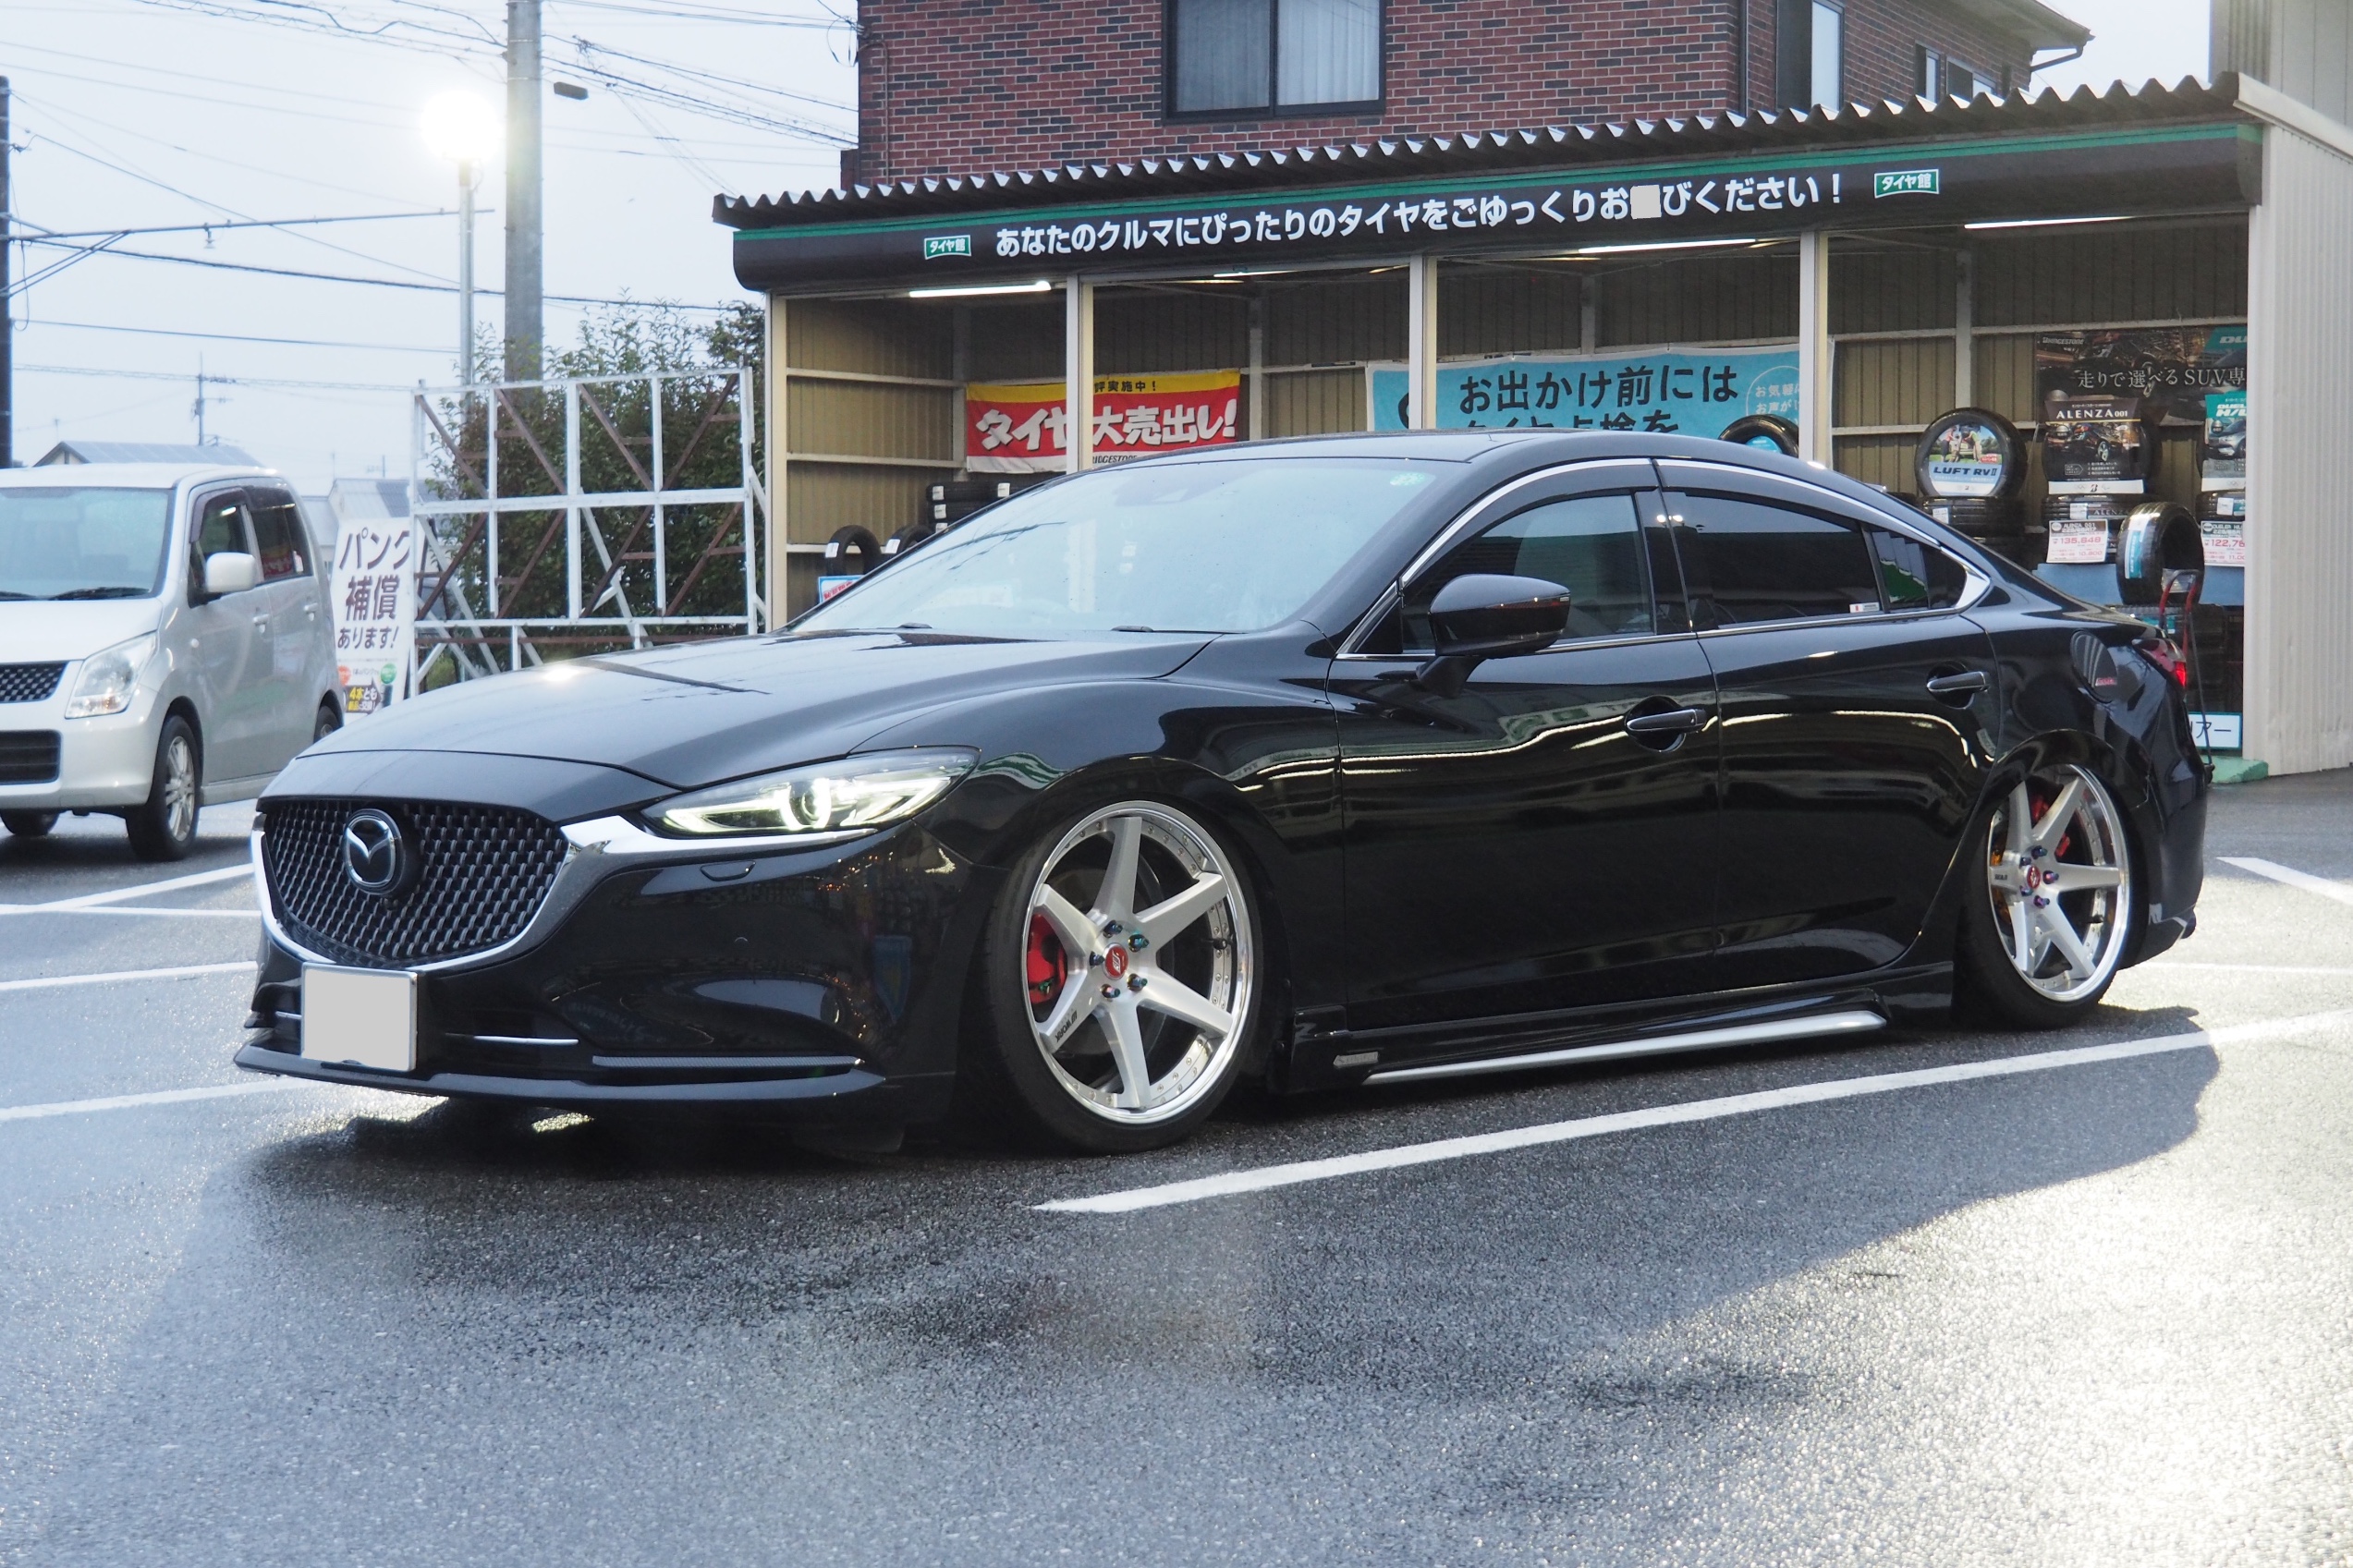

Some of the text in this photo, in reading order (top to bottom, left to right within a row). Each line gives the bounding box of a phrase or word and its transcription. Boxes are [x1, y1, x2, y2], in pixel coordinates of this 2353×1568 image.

[1882, 174, 1931, 190] タイヤ館
[996, 173, 1839, 258] あなたのクルマにぴったりのタイヤをごゆっくりおびください！
[930, 238, 966, 254] タイヤ館
[1459, 364, 1737, 415] お出かけ前には
[2056, 408, 2114, 419] ALENZA
[1933, 466, 1971, 475] LUFT
[338, 527, 410, 571] パンク
[346, 574, 401, 622] 補償
[337, 626, 399, 650] あります!
